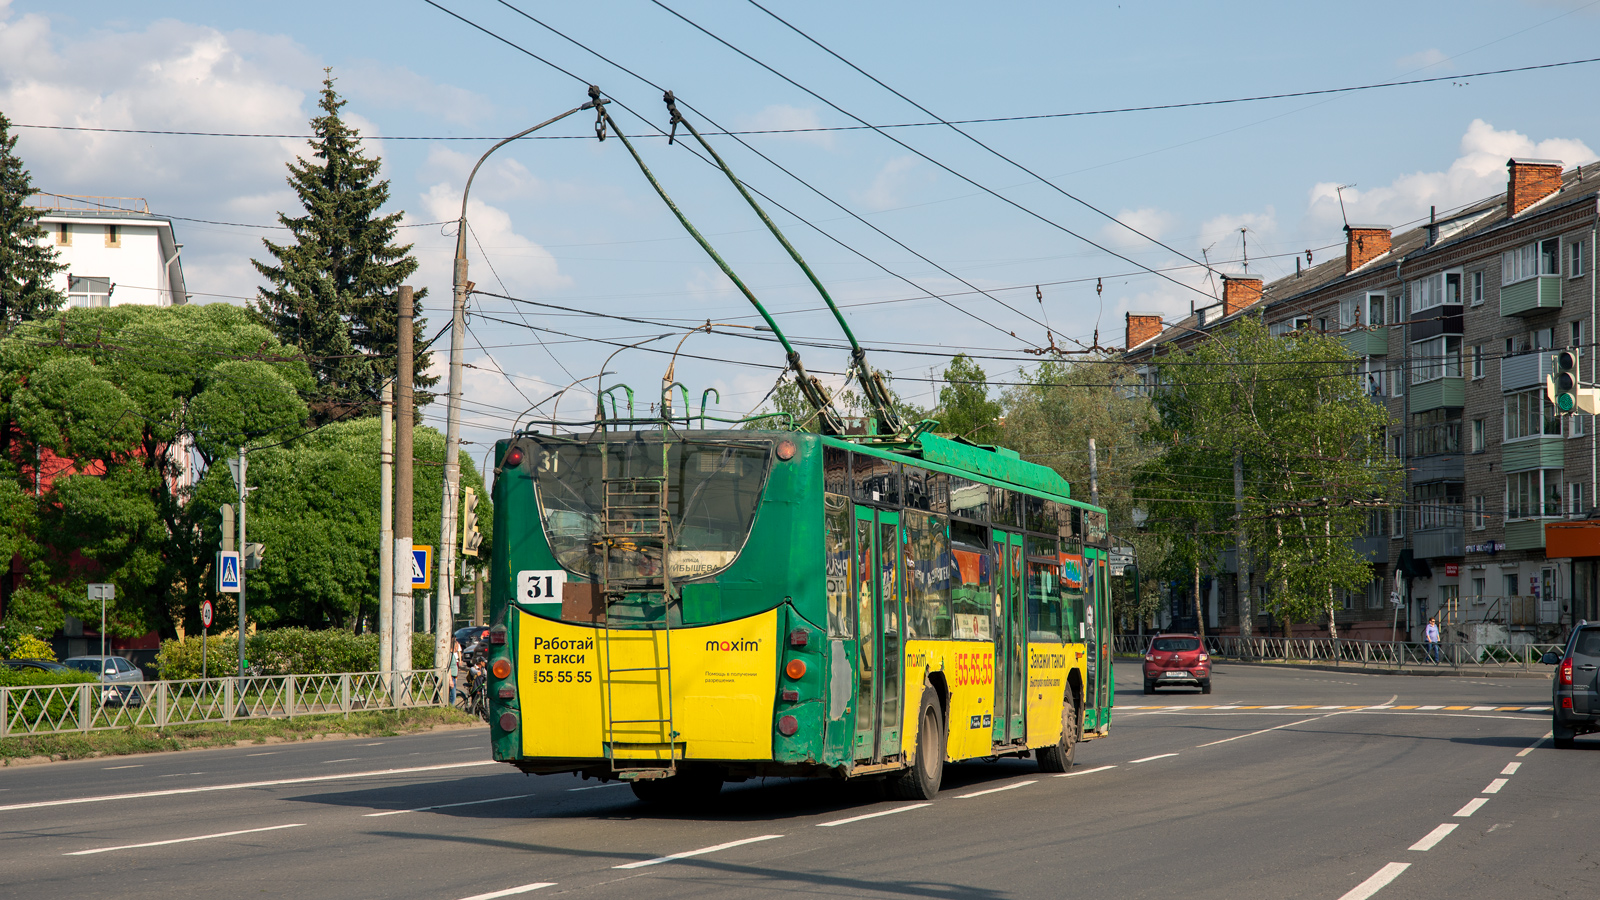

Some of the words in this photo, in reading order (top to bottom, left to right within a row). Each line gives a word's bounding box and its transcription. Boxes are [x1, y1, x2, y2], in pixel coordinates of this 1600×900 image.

[537, 450, 559, 473] 31
[527, 575, 555, 599] 31
[204, 609, 211, 619] 40
[534, 636, 594, 650] Работай
[533, 654, 541, 664] в
[544, 654, 585, 664] такси
[1030, 647, 1051, 669] Закажи
[1051, 653, 1066, 669] такси
